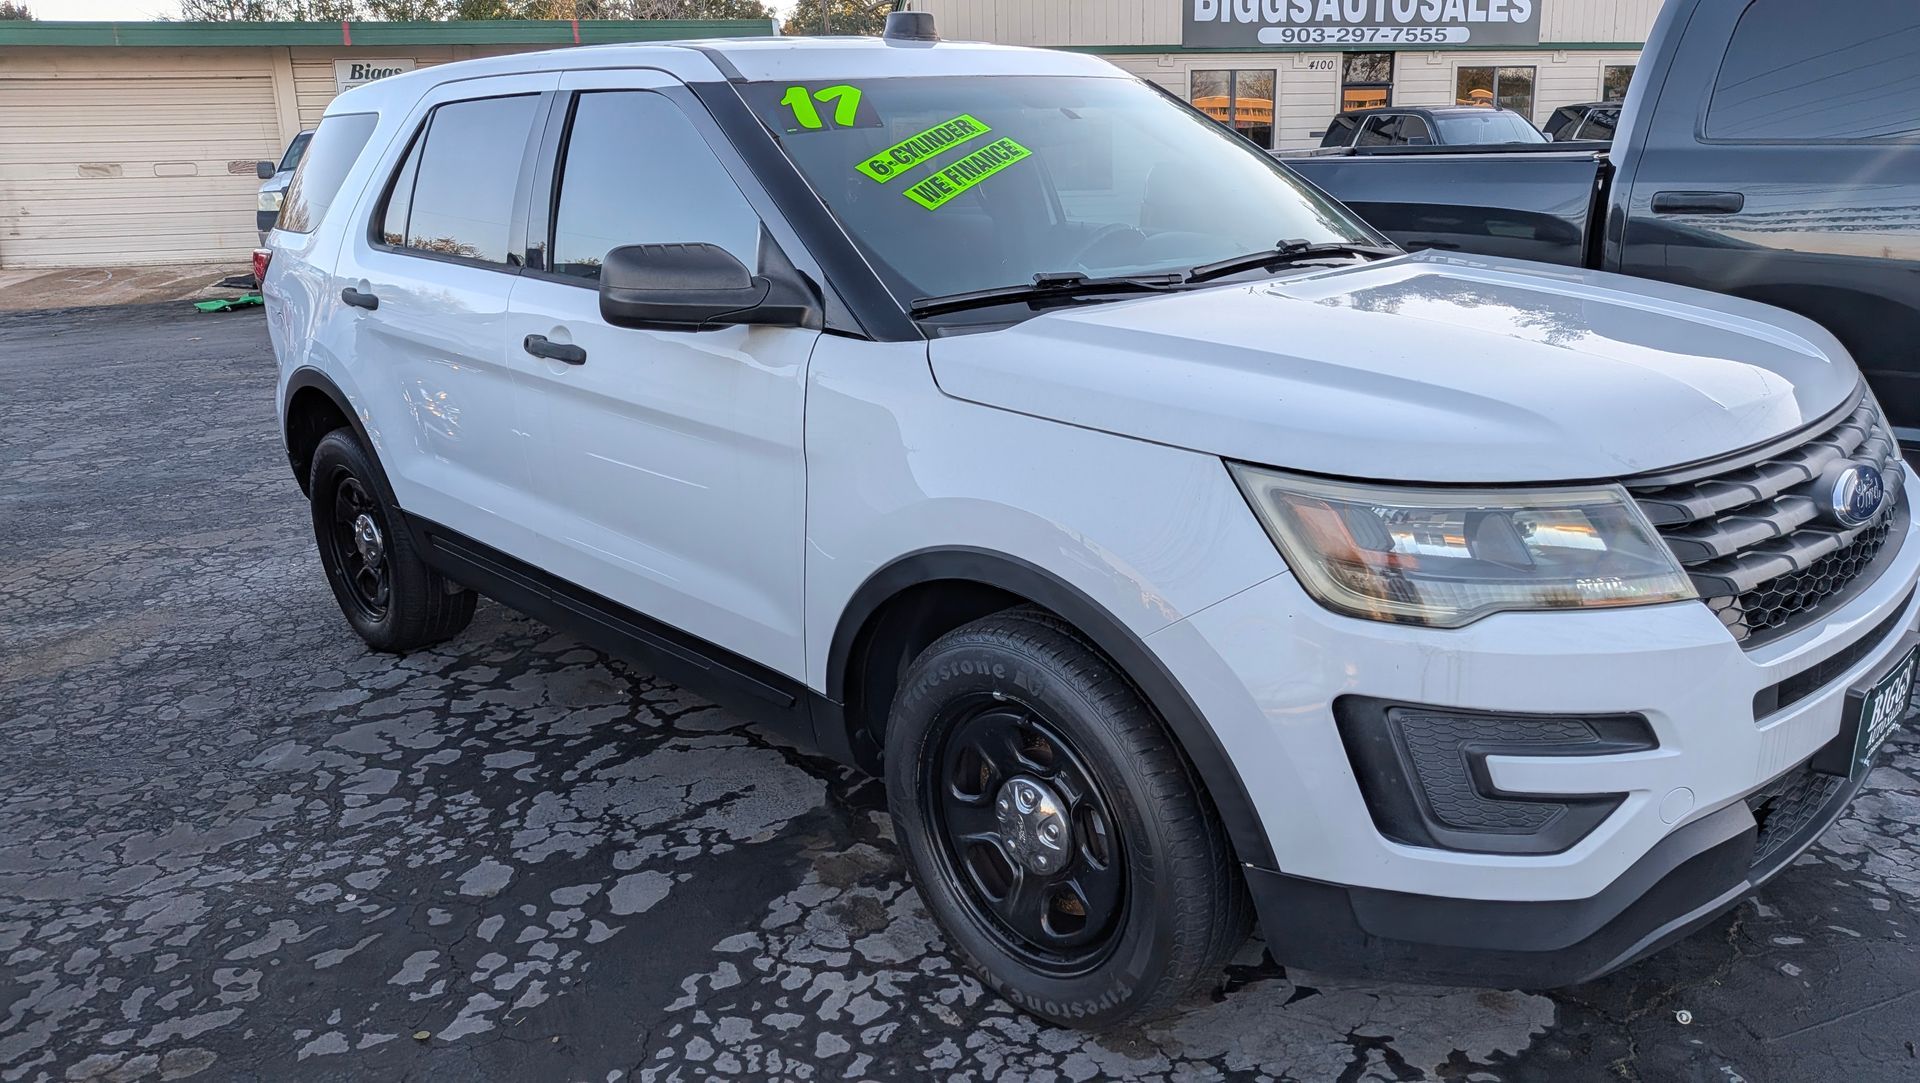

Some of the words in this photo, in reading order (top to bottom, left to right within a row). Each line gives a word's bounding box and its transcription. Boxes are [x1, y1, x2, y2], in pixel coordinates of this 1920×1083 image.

[1281, 28, 1448, 43] 903-297-7555
[1309, 60, 1334, 70] 4100
[781, 85, 862, 128] 17
[869, 119, 978, 176] 6-CYLINDER
[912, 176, 956, 204] WE
[942, 140, 1023, 187] FINANCE
[1855, 476, 1881, 513] Ford
[1009, 981, 1133, 1019] Firestone
